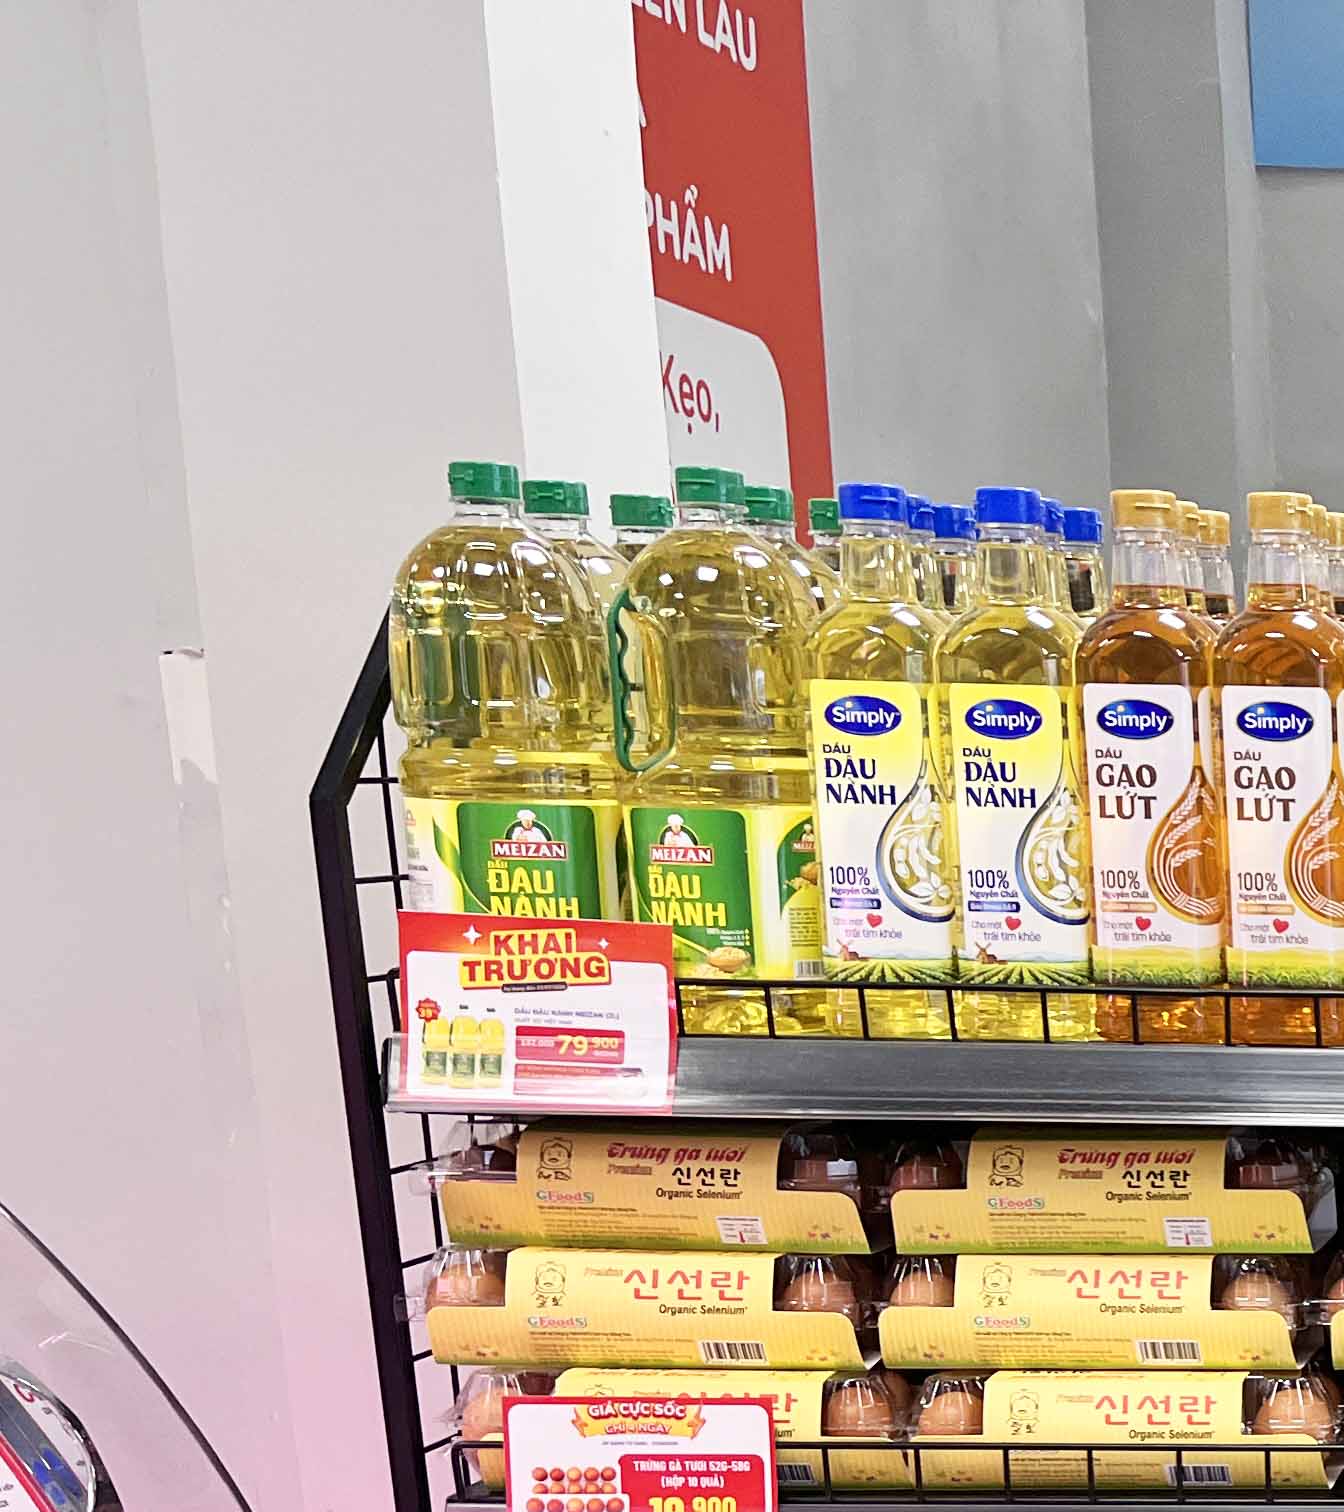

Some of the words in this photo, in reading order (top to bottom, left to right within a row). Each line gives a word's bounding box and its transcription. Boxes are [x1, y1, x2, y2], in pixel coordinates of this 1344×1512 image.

[832, 701, 897, 727] Simply
[974, 705, 1039, 732] Simply
[1104, 705, 1170, 731] Simply
[1244, 707, 1309, 734] Simply
[1096, 763, 1157, 793] GẠO
[1099, 789, 1157, 820] LỨT
[493, 841, 567, 859] MEIZAN
[651, 847, 712, 864] MEIZAN
[830, 866, 871, 886] 100%
[968, 869, 1010, 889] 100%
[493, 931, 574, 956] KHAI
[463, 956, 608, 984] TRƯƠNG
[556, 1035, 588, 1055] 79
[672, 1166, 742, 1187] 신선란
[656, 1188, 694, 1201] Organic
[624, 1268, 750, 1301] 신선란
[659, 1304, 698, 1316] Organic
[588, 1403, 616, 1418] GIÁ
[654, 1401, 687, 1418] SỐC
